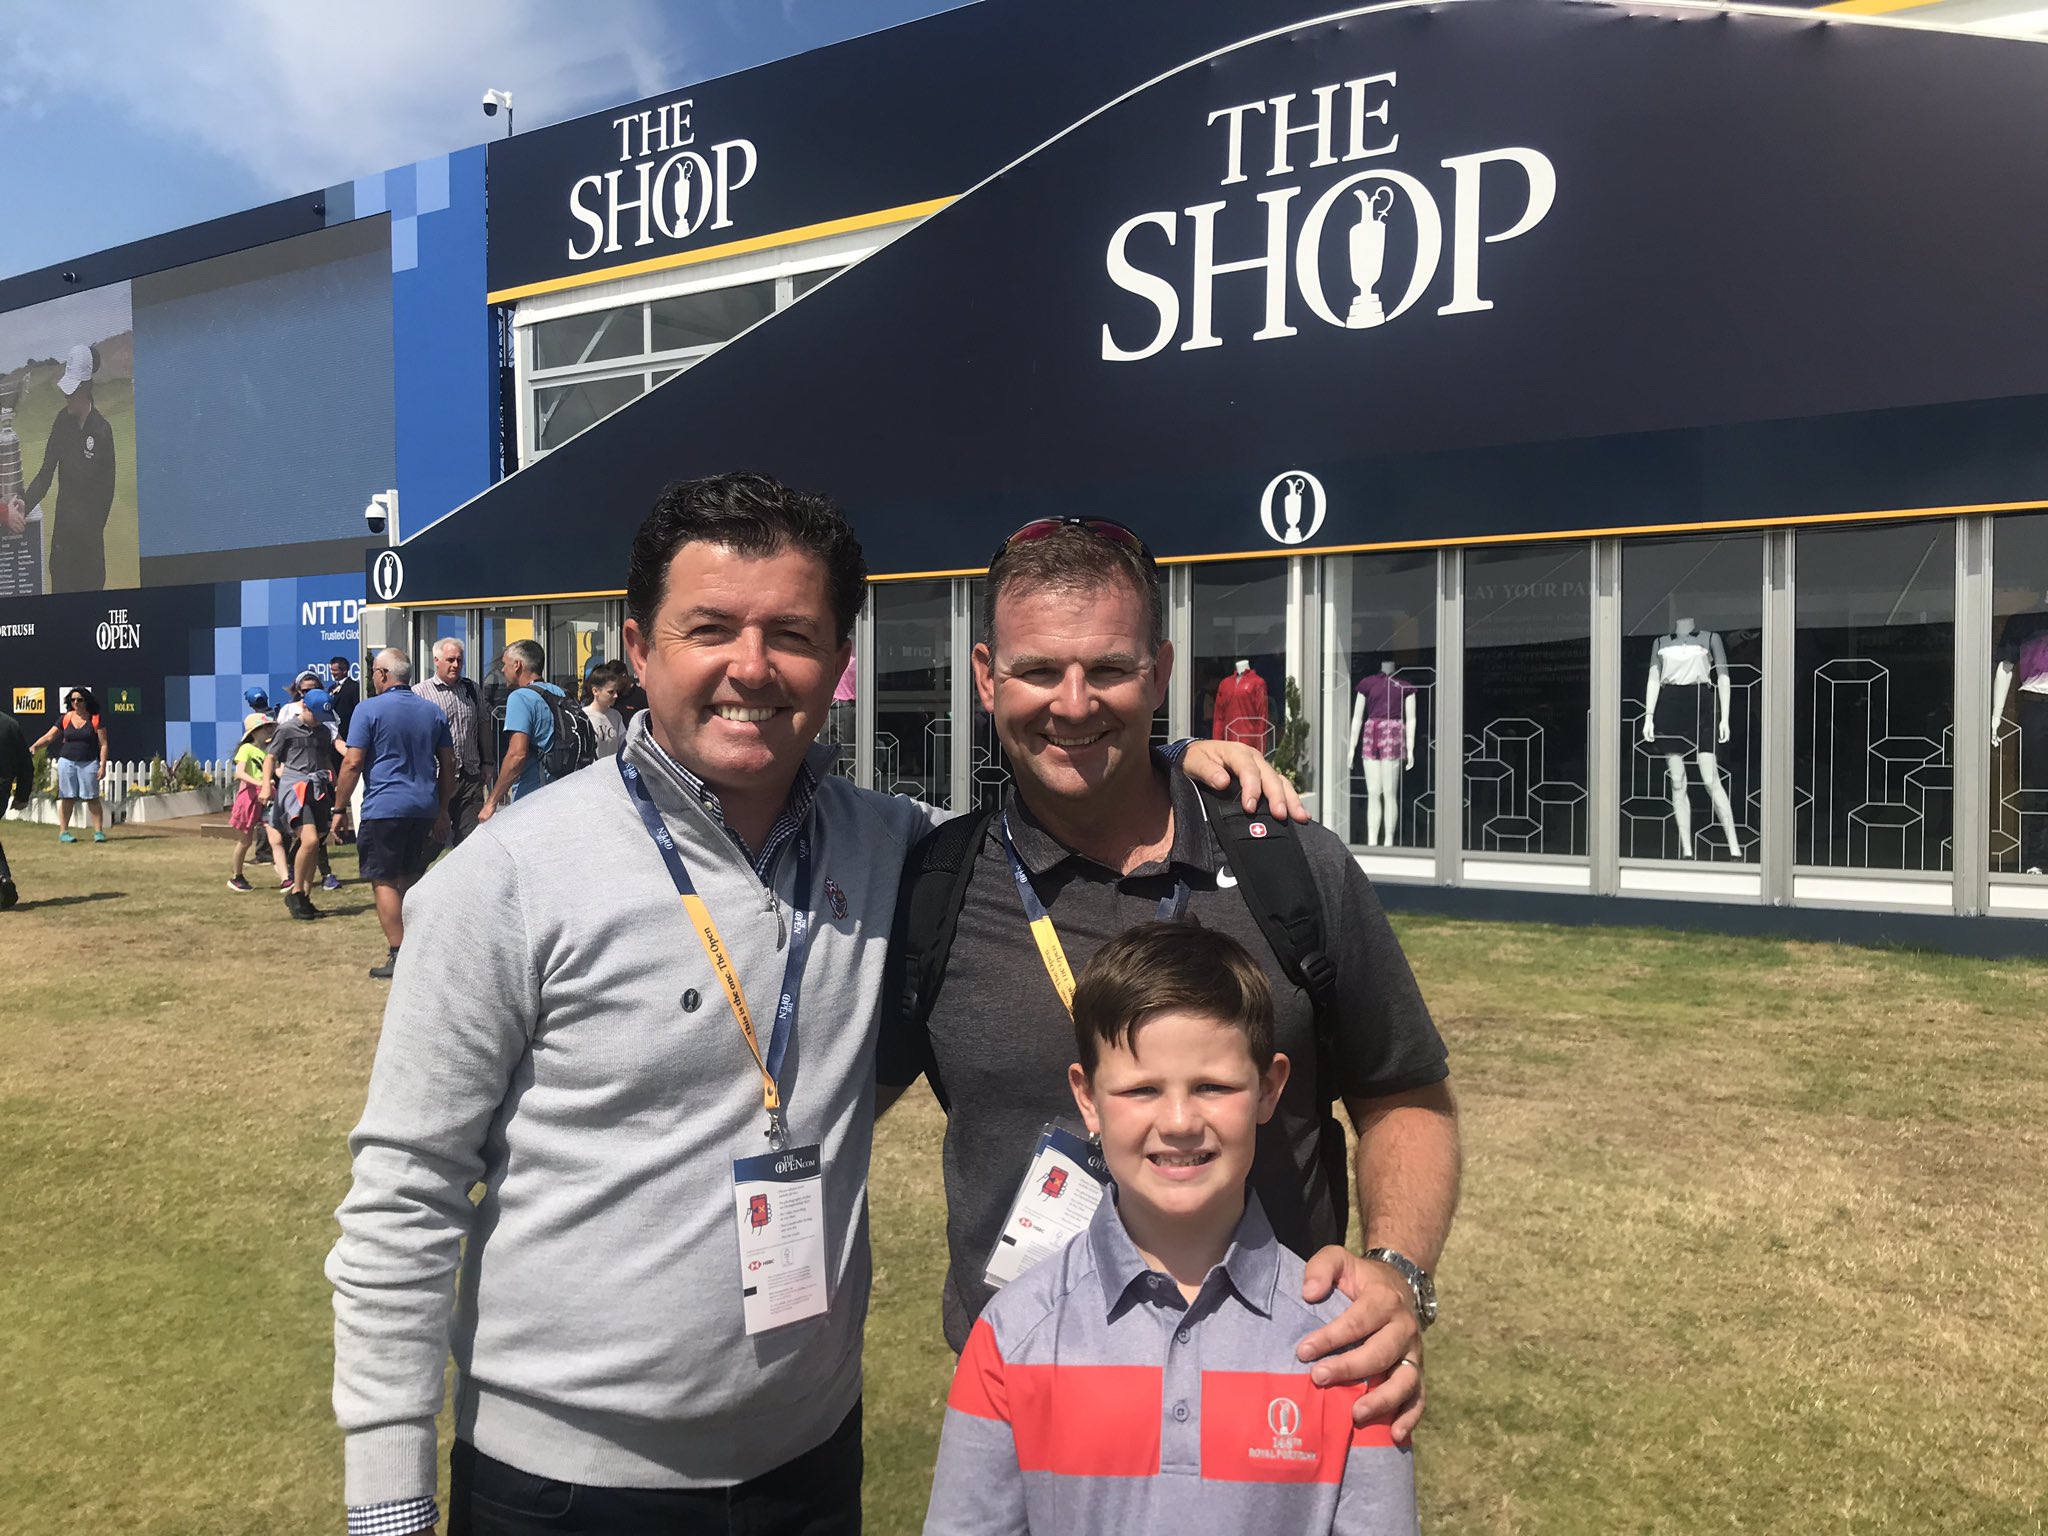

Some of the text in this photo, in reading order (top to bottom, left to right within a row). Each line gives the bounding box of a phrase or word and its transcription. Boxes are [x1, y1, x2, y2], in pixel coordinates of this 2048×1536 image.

[613, 99, 695, 162] THE
[1207, 71, 1399, 186] THE
[568, 139, 758, 261] SHOP
[1101, 147, 1557, 362] SHOP
[1503, 582, 1558, 599] YOUR
[1562, 580, 1591, 598] PA
[108, 609, 128, 624] THE
[302, 600, 341, 626] NTT
[0, 623, 35, 637] RTRUSH
[96, 621, 141, 650] OPEN
[320, 631, 346, 641] Trusted
[15, 696, 43, 711] Nikon
[114, 703, 135, 712] ROLEX
[596, 725, 615, 741] YC
[656, 826, 674, 850] OPEN
[794, 910, 804, 934] OPEN
[704, 927, 719, 953] Open
[716, 952, 727, 972] The
[732, 991, 742, 1007] the
[779, 993, 791, 1020] OPEN
[739, 1007, 745, 1016] is
